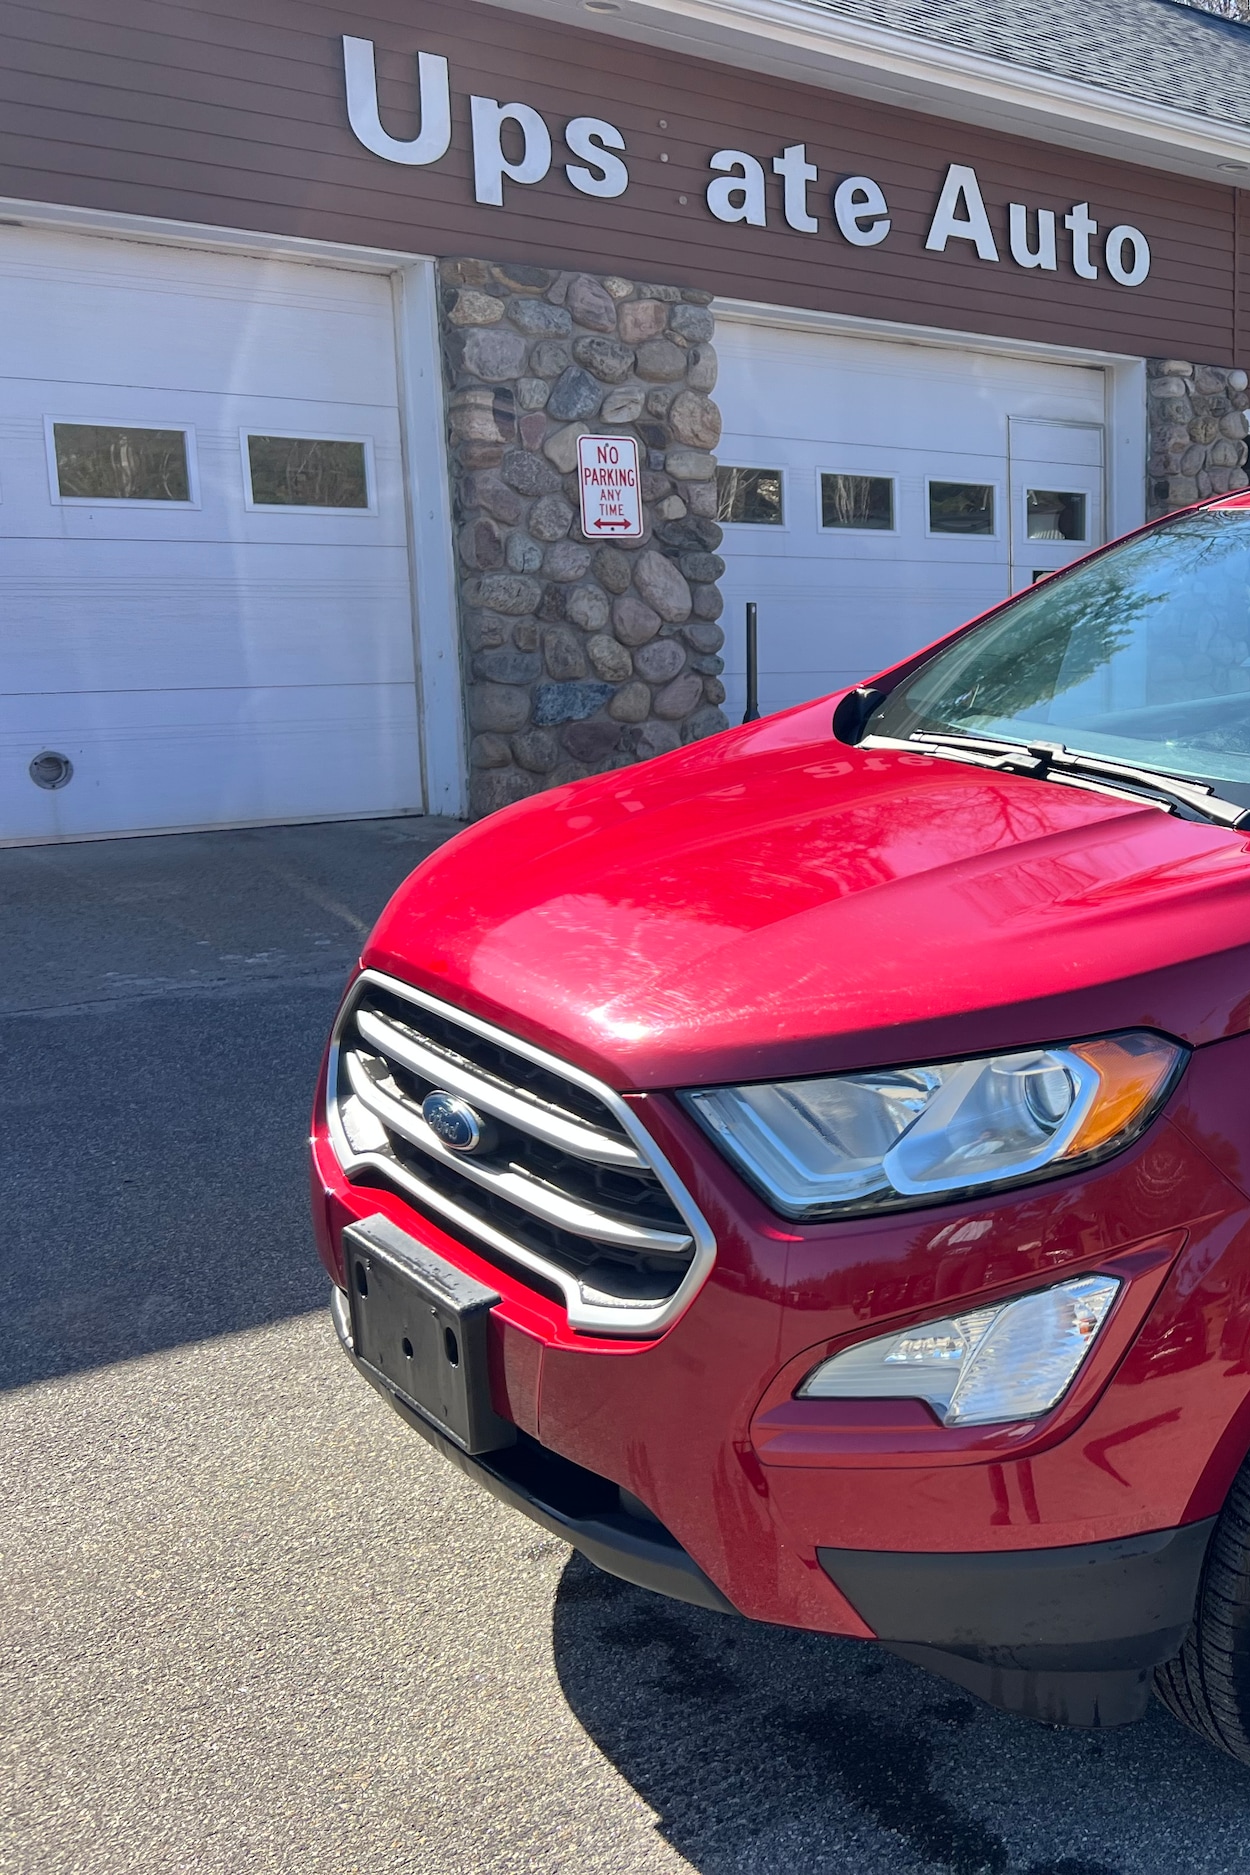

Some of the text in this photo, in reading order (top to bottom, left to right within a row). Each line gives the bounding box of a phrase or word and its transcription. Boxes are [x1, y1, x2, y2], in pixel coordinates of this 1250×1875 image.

[342, 34, 1152, 288] Ups ate Auto
[597, 446, 619, 465] NO
[584, 467, 635, 487] PARKING
[600, 489, 622, 502] ANY
[599, 504, 625, 516] TIME
